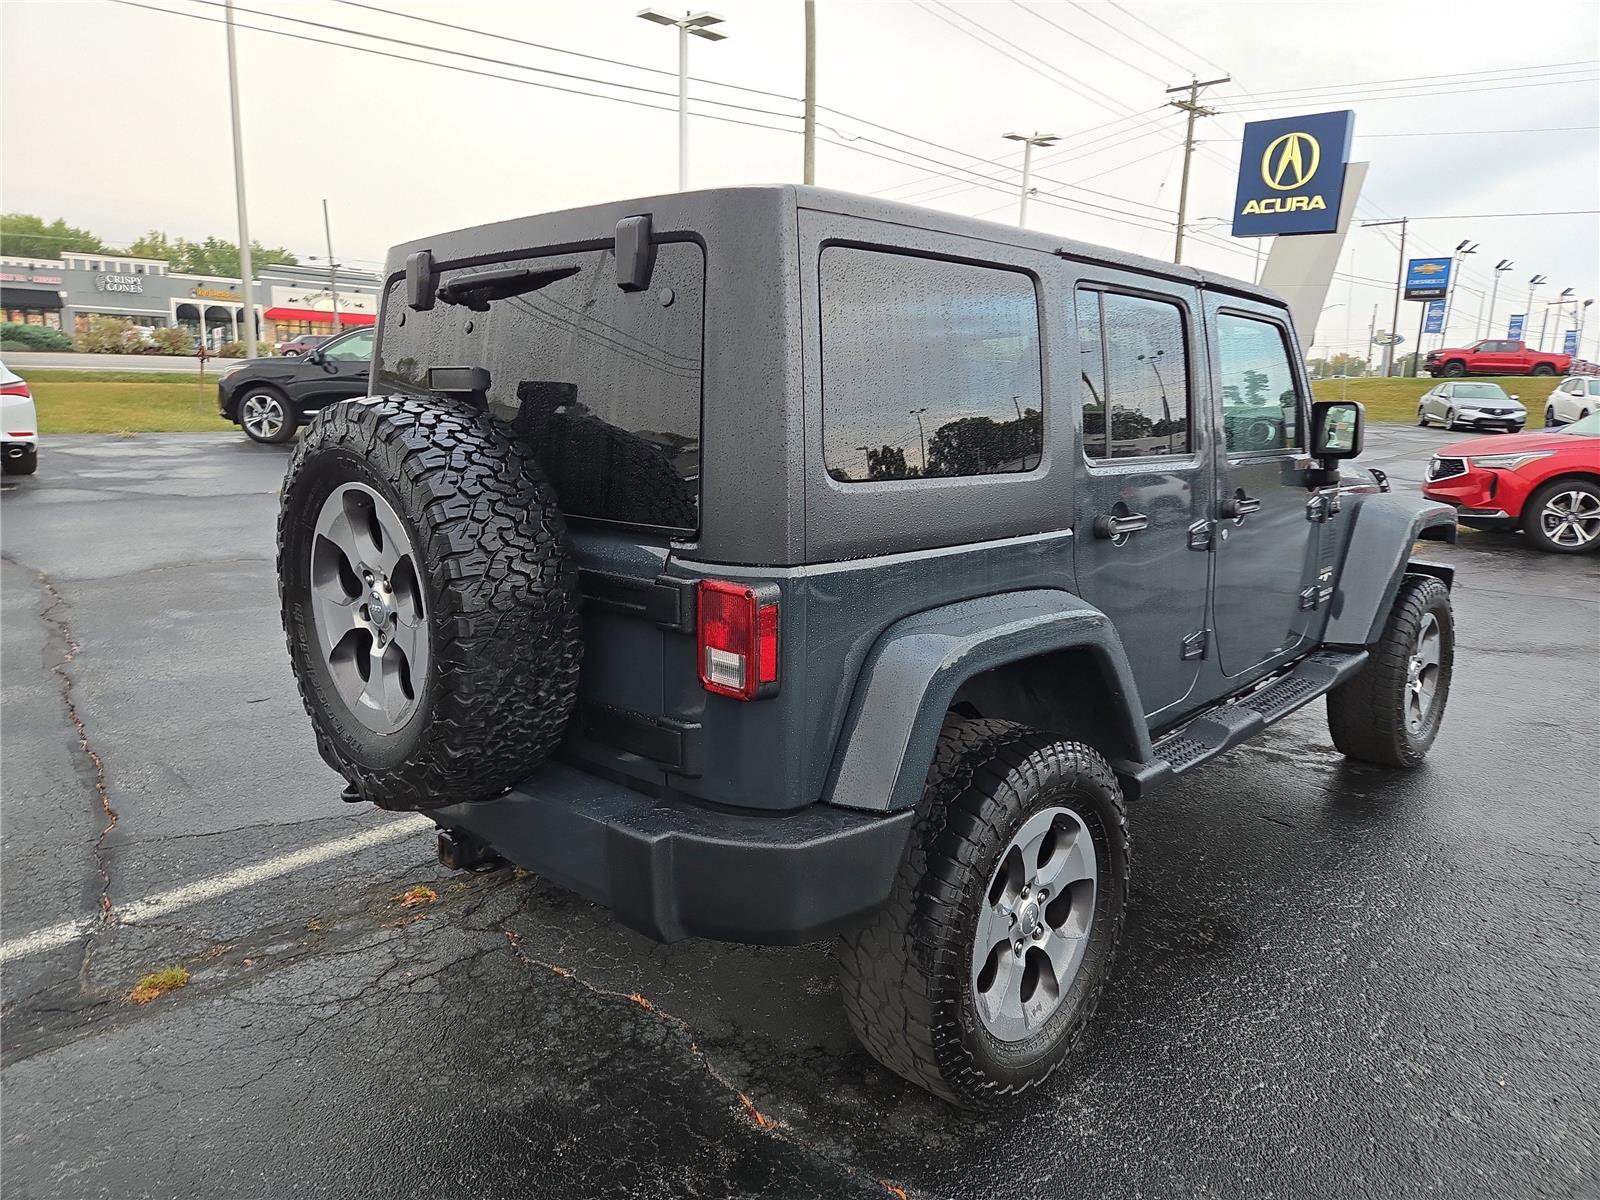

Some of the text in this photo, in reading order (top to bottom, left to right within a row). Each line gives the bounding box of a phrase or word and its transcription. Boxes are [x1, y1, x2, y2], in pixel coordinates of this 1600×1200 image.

[1243, 194, 1327, 215] ACURA
[106, 275, 143, 285] CRISPY
[106, 283, 143, 293] CONES
